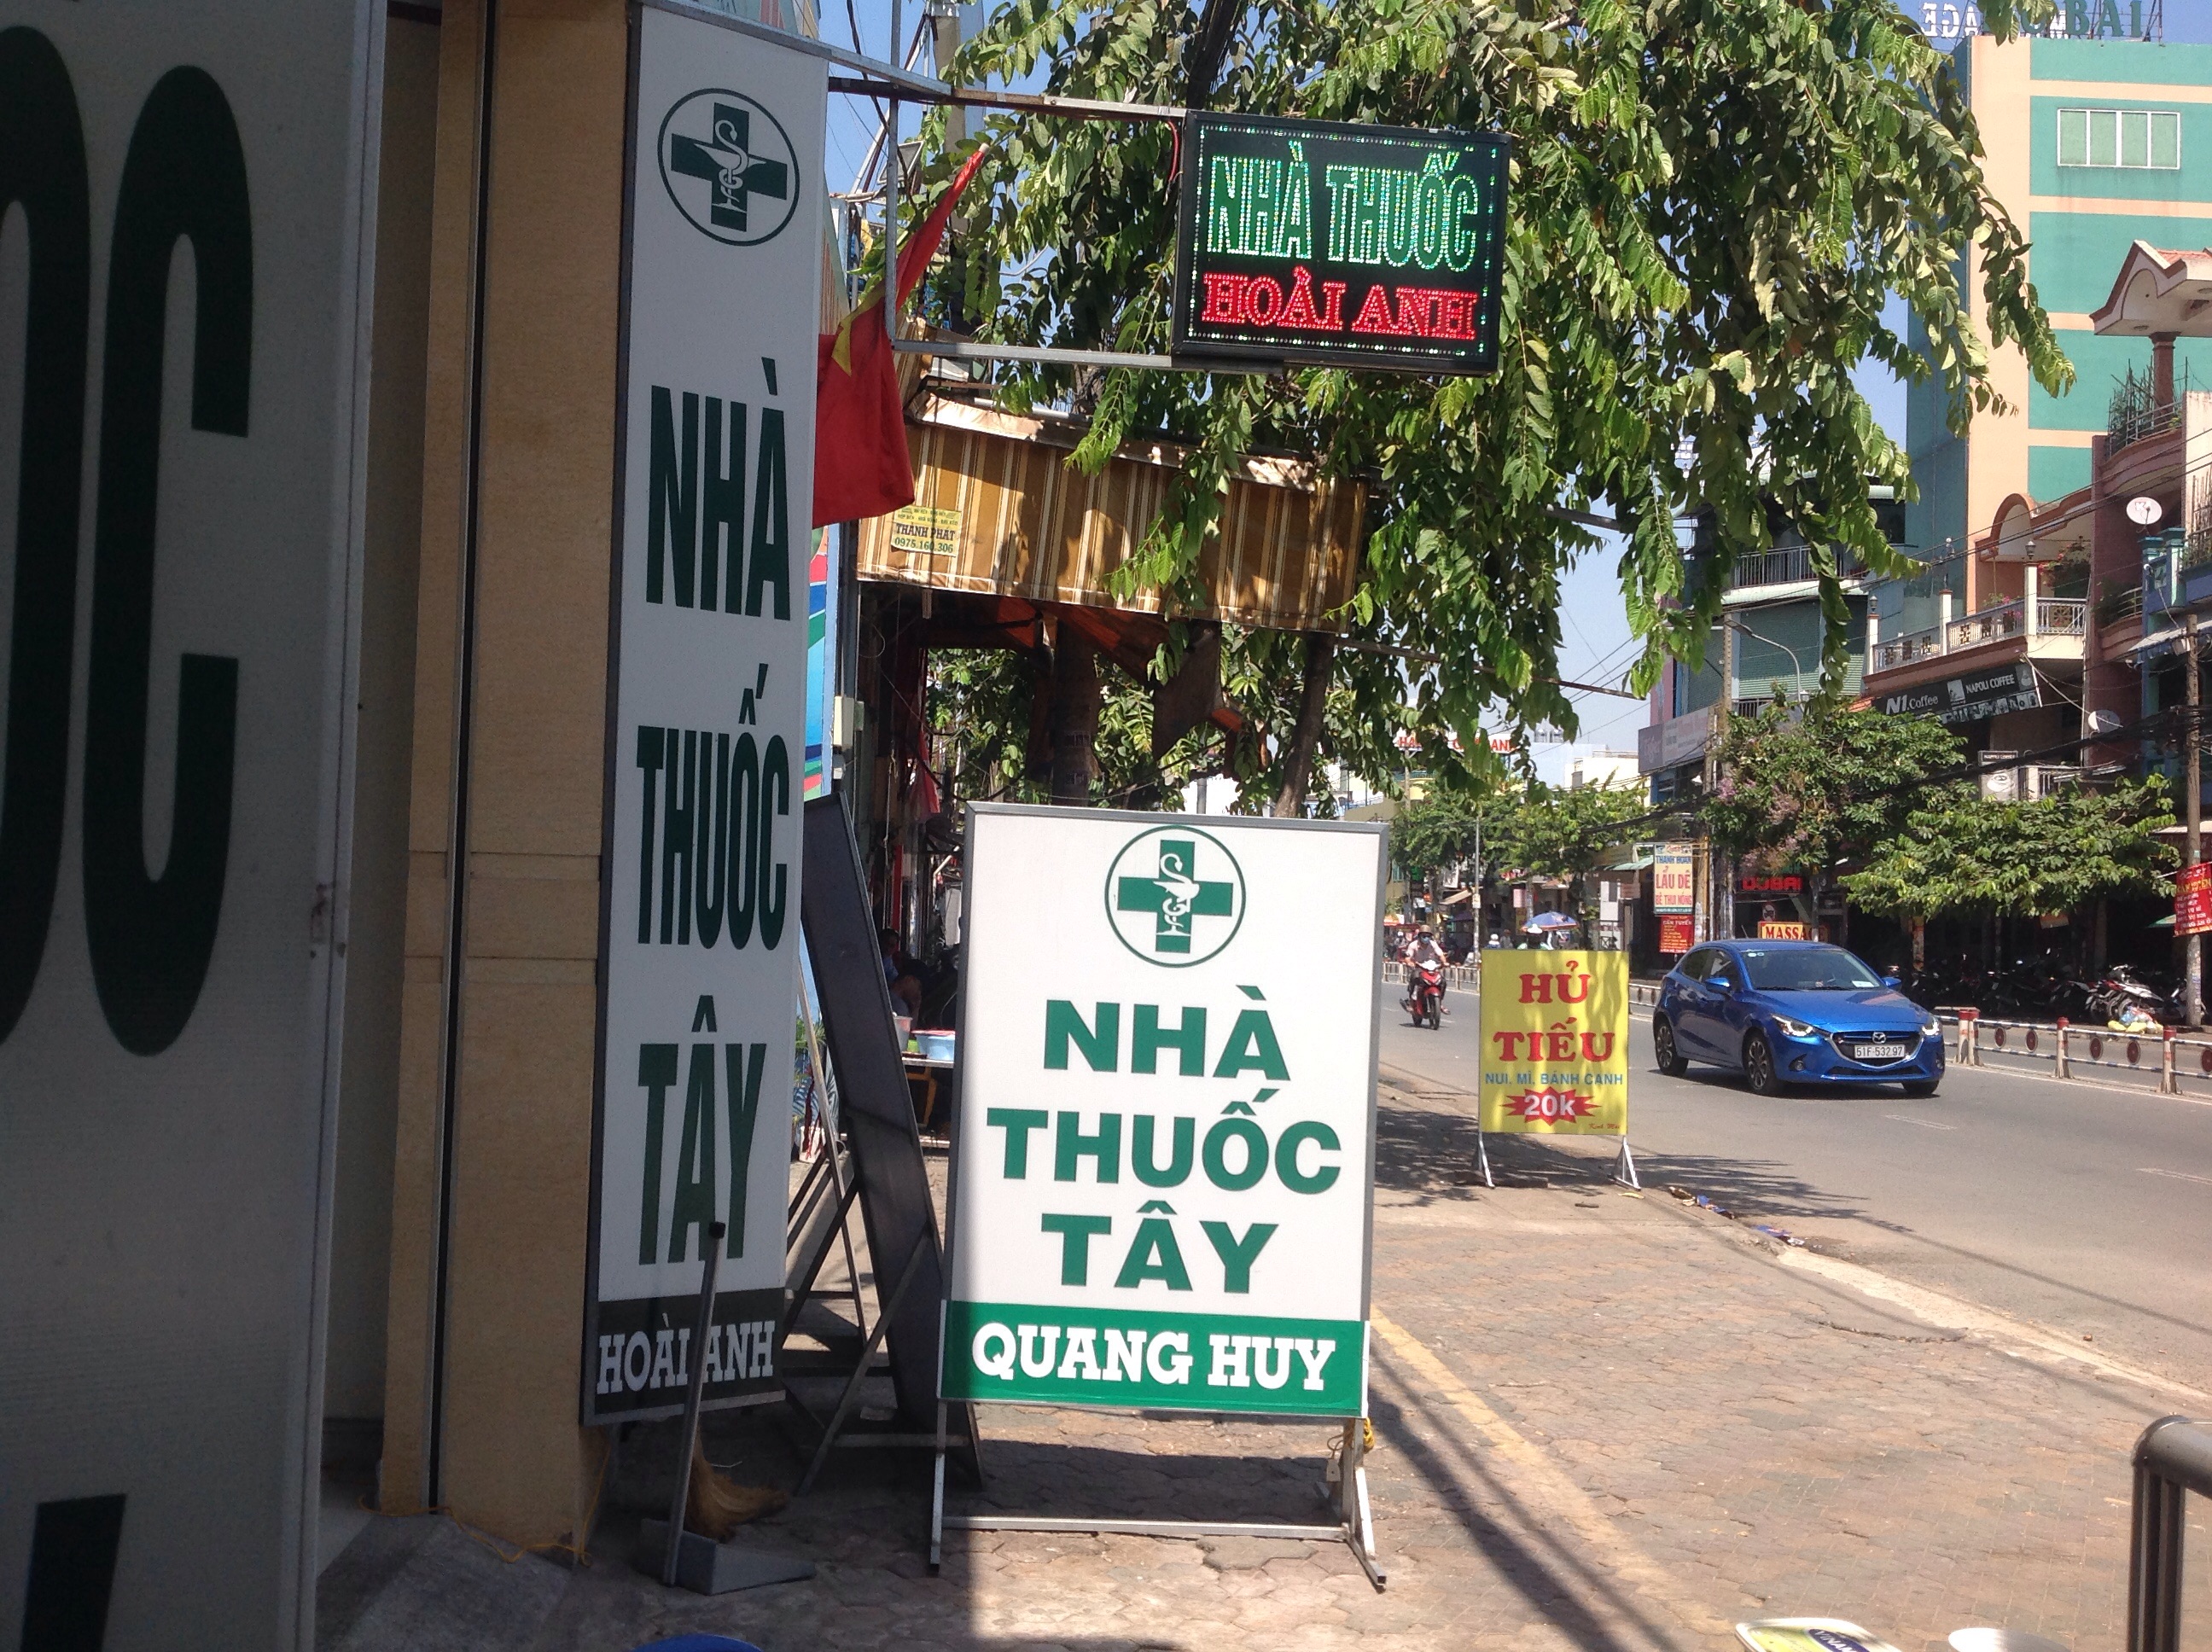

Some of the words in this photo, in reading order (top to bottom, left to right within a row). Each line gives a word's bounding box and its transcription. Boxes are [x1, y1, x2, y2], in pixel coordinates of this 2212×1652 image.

[1206, 139, 1312, 259] NHÀ
[1325, 151, 1478, 272] THUỐC
[1201, 265, 1348, 331] HOÀI
[1351, 284, 1479, 340] ANH
[645, 356, 791, 621] NHÀ
[1965, 679, 1988, 695] NAPOLI
[1989, 673, 2016, 689] COFFEE
[636, 662, 790, 951] THUỐC
[1656, 865, 1674, 889] LẨU
[1678, 870, 1691, 889] DÊ
[1518, 960, 1592, 1004] HỦ
[1043, 984, 1291, 1082] NHÀ
[1493, 1016, 1615, 1062] TIẾU
[1540, 1070, 1580, 1085] BÁNH
[1584, 1073, 1623, 1085] CANH
[638, 995, 767, 1265] TÂY
[987, 1088, 1342, 1195] THUỐC
[1041, 1200, 1279, 1294] TÂY
[597, 1312, 690, 1394] HOÀI
[700, 1320, 775, 1385] ANH
[972, 1322, 1194, 1385] QUANG
[1207, 1335, 1336, 1391] HUY
